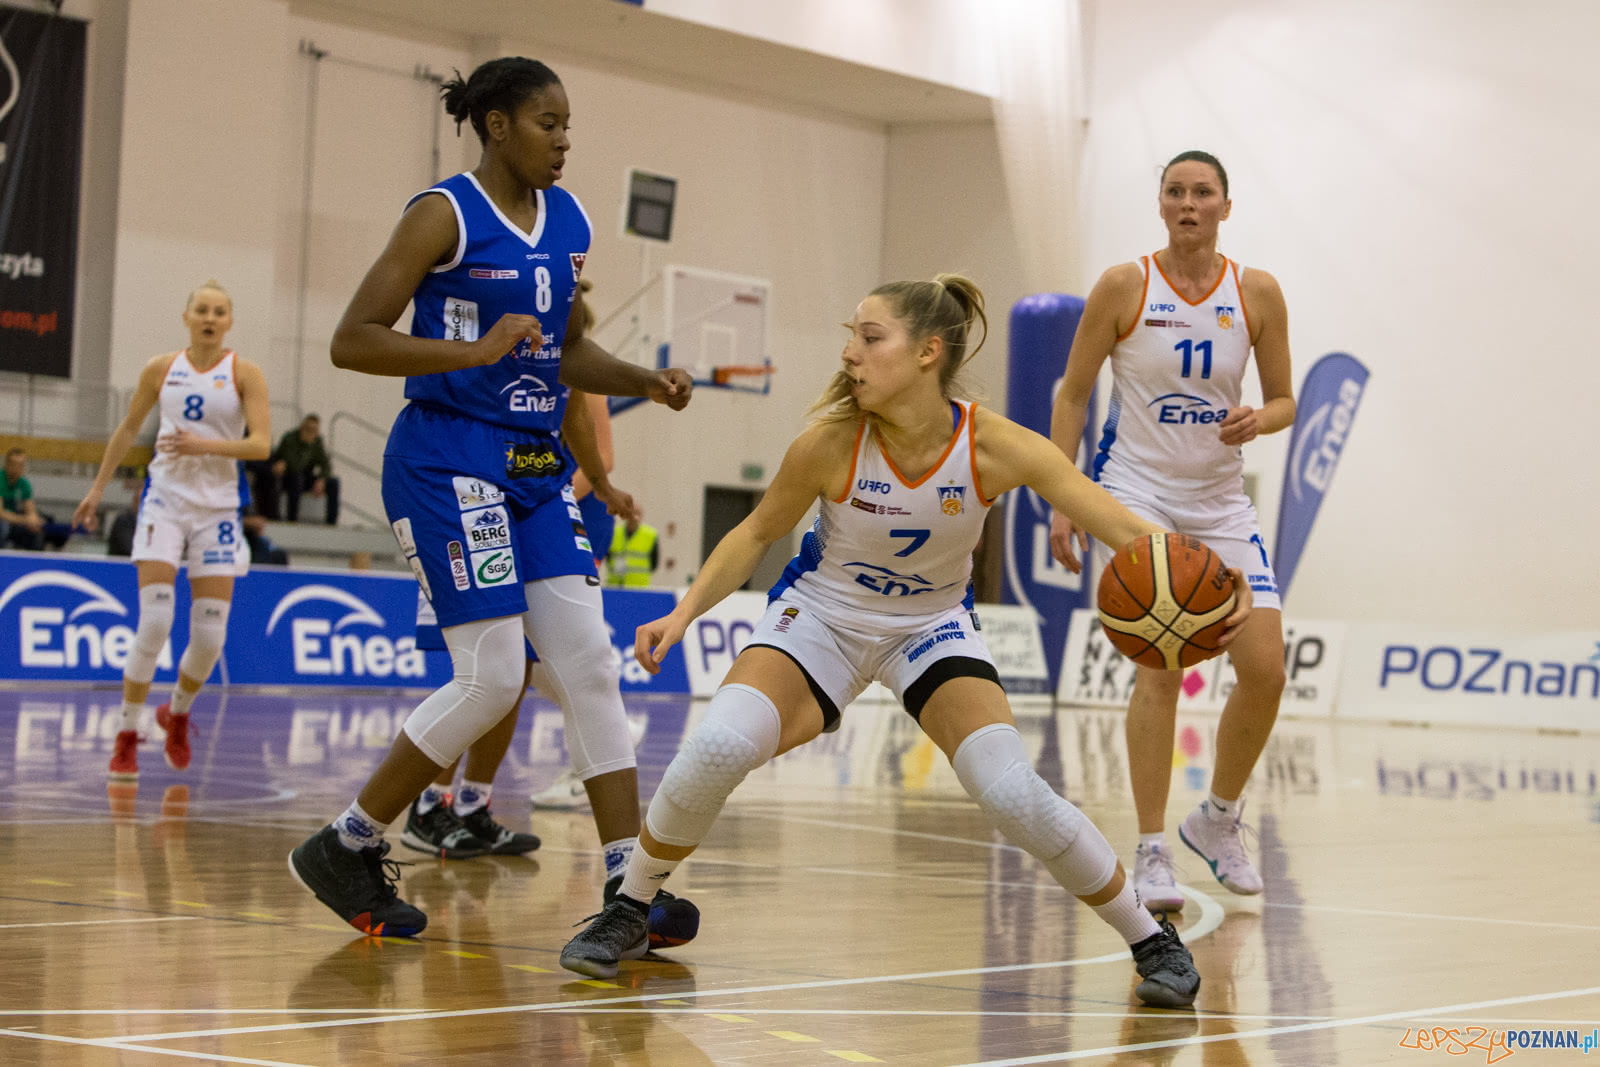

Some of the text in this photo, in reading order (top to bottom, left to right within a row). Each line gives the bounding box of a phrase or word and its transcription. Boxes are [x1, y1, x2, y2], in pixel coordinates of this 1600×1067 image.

[534, 266, 552, 313] 8
[1174, 339, 1212, 379] 11
[183, 394, 204, 421] 8
[217, 521, 234, 545] 8
[472, 525, 507, 542] BERG
[889, 529, 931, 557] 7
[487, 564, 507, 574] SGB
[292, 618, 426, 678] Enea
